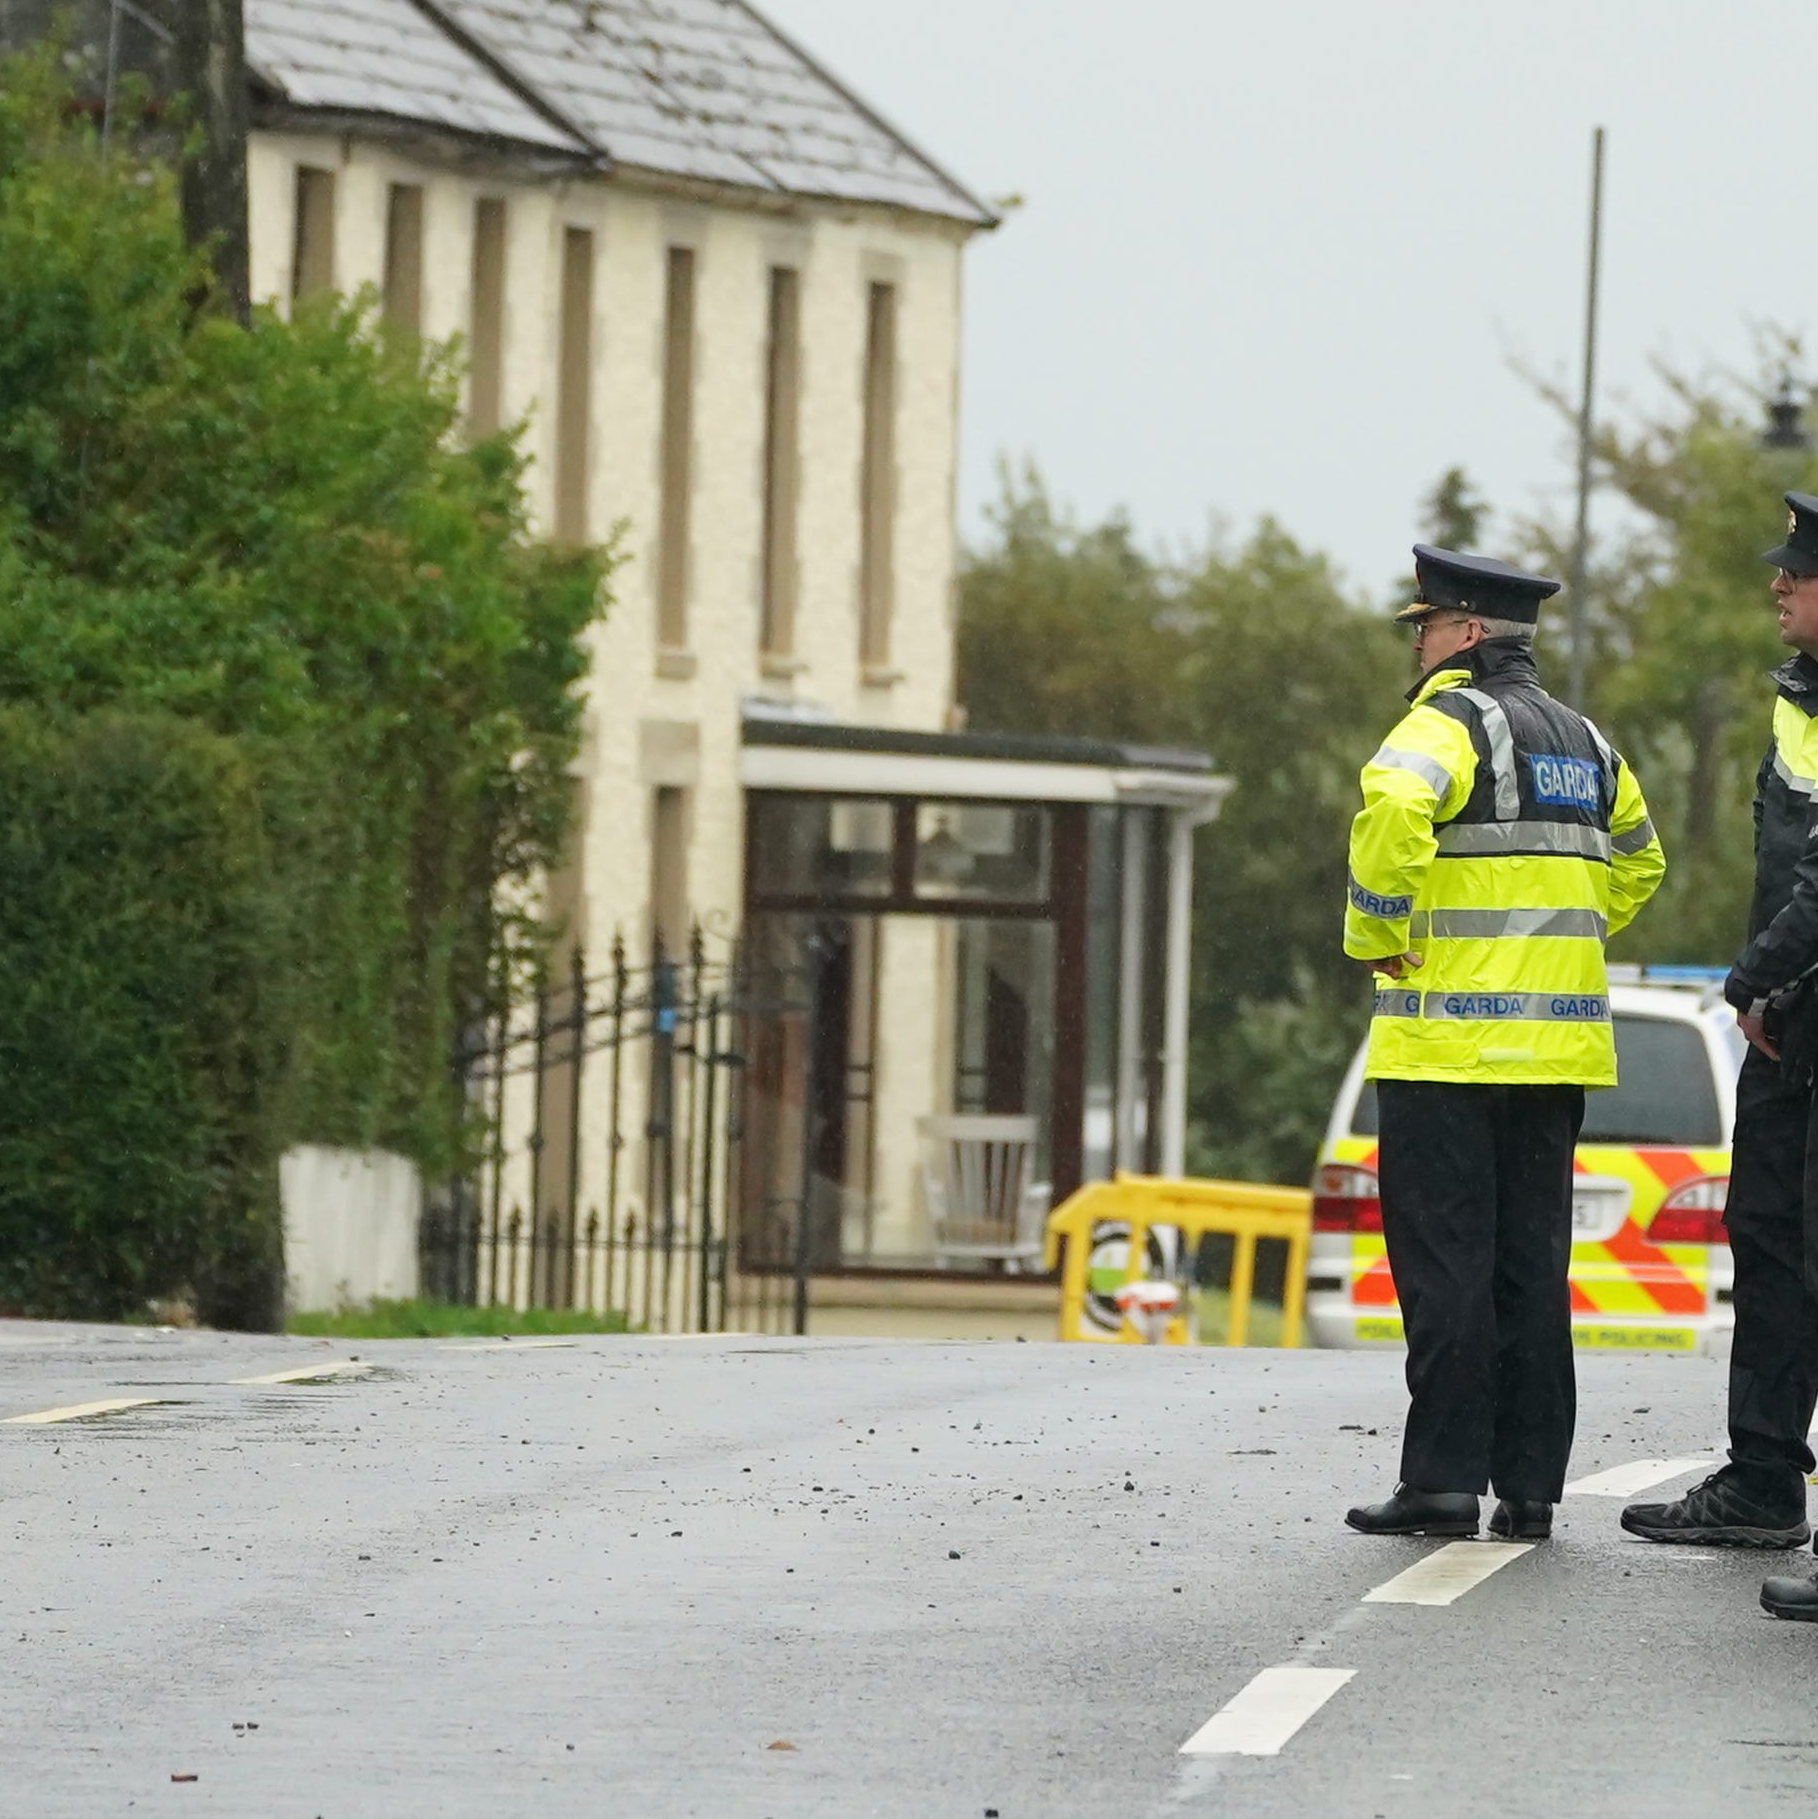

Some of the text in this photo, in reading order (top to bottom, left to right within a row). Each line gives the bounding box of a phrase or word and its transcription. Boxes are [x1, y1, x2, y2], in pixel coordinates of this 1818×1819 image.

[1537, 761, 1598, 804] GARDA
[1353, 890, 1410, 915] ARDA
[1444, 997, 1524, 1014] GARDA
[1550, 998, 1609, 1017] GARDA
